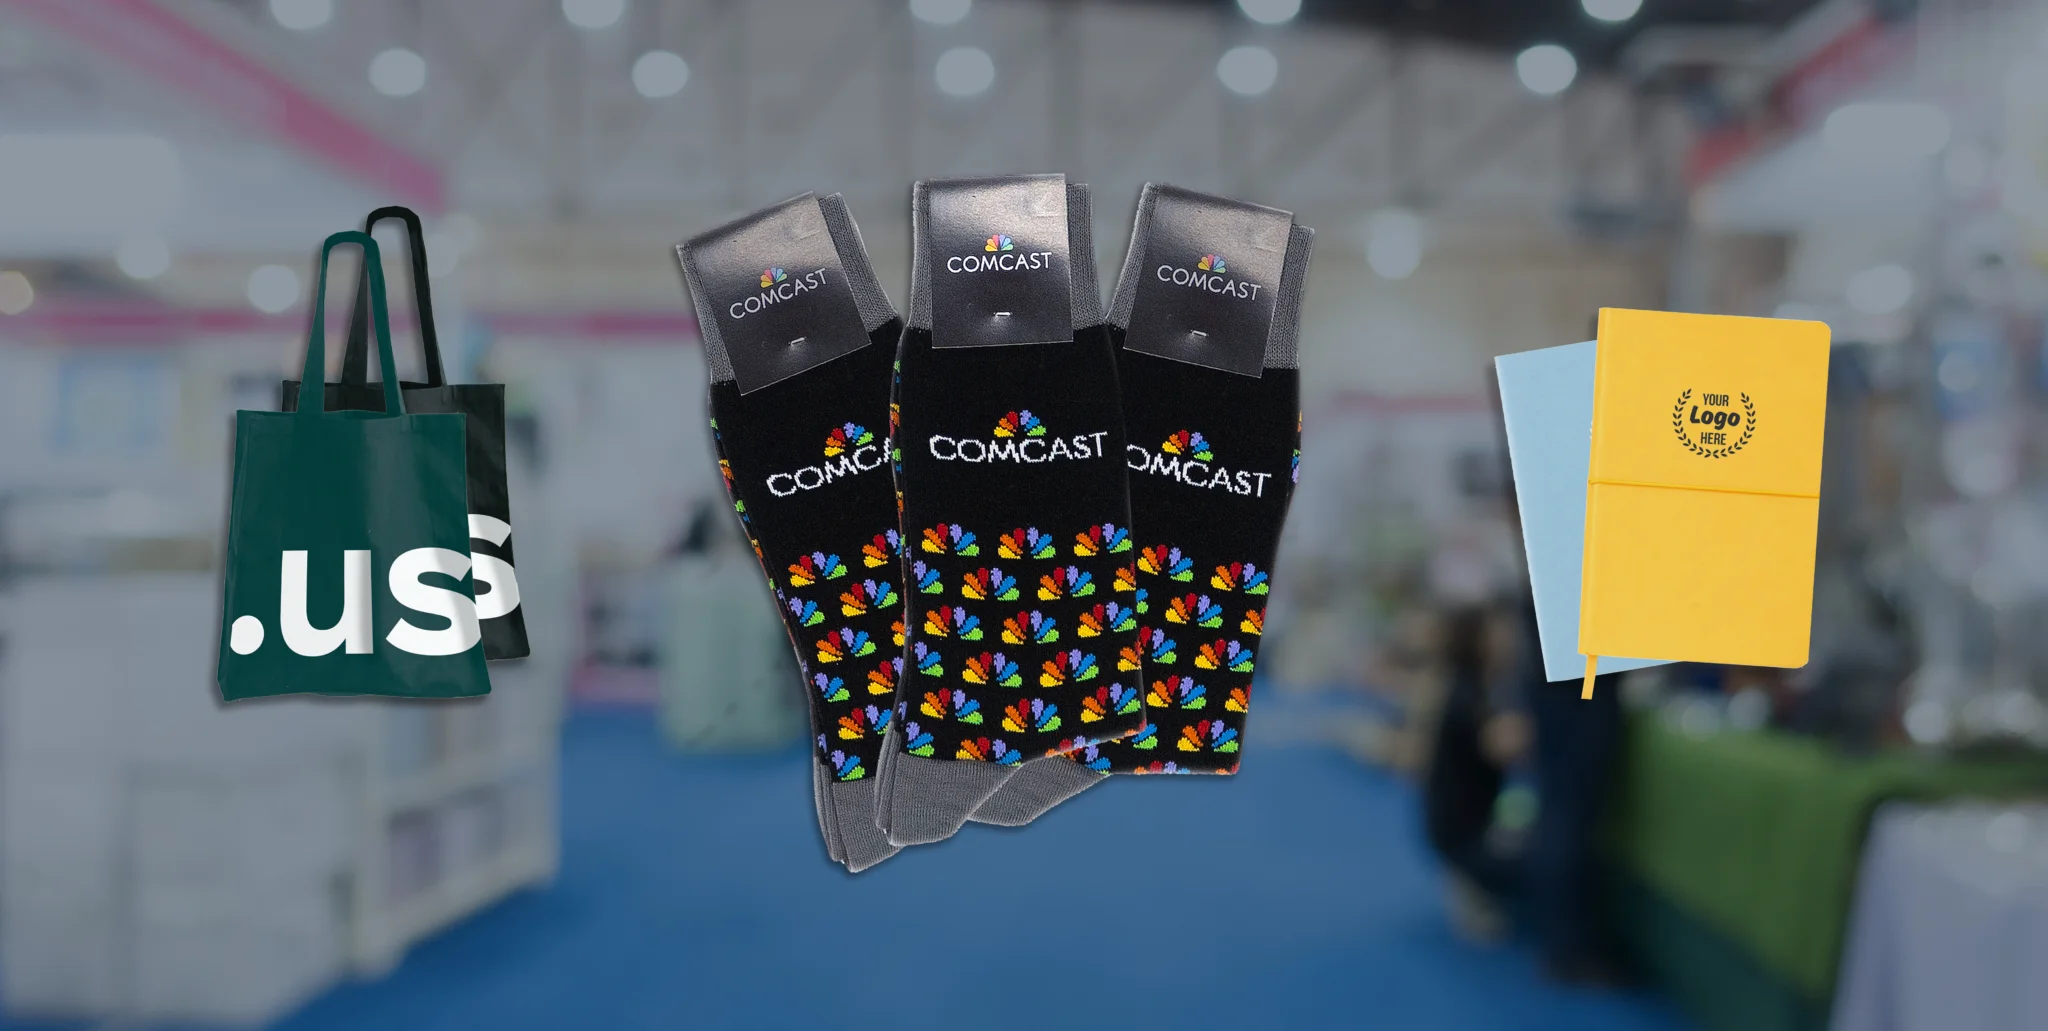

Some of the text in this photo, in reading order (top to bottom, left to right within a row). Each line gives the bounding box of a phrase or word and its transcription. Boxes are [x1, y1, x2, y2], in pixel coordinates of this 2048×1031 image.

[947, 252, 1052, 273] COMCAST
[730, 268, 826, 318] COMCAST
[1157, 265, 1261, 300] COMCAST
[1703, 393, 1729, 406] YOUR
[1689, 405, 1741, 430] Logo
[929, 431, 1108, 463] COMCAST
[1700, 432, 1727, 446] HERE
[1126, 444, 1272, 498] OMCAST
[230, 547, 482, 657] .us
